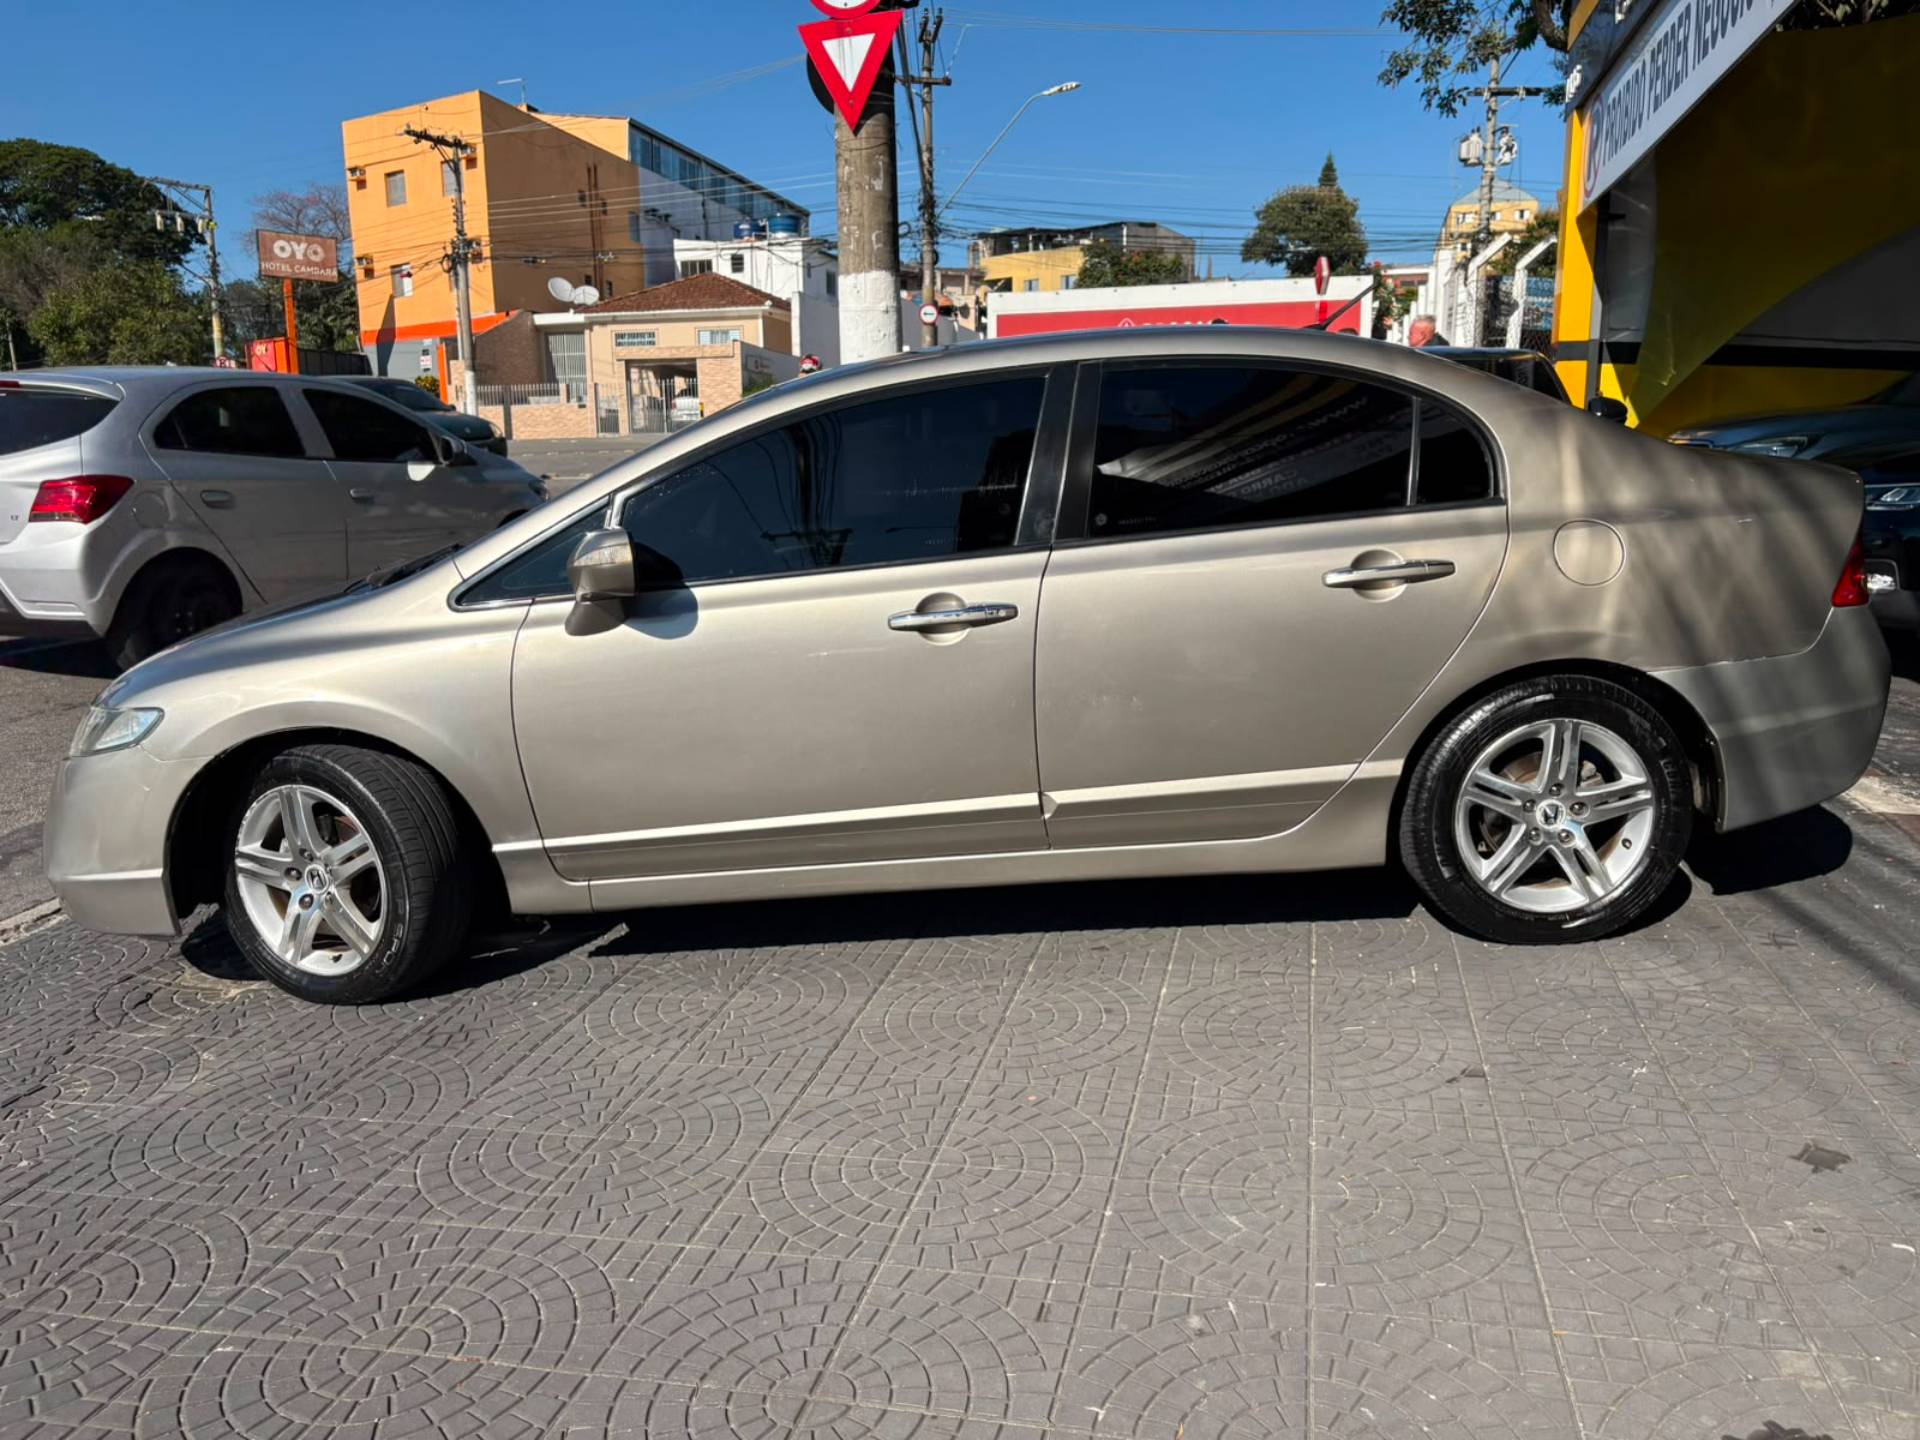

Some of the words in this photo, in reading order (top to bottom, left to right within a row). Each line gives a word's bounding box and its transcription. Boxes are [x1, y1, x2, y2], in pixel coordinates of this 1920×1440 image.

[1602, 57, 1647, 168] PROIBIDO
[1646, 2, 1692, 121] PERDER
[272, 239, 325, 262] OYO
[261, 261, 293, 273] HOTEL
